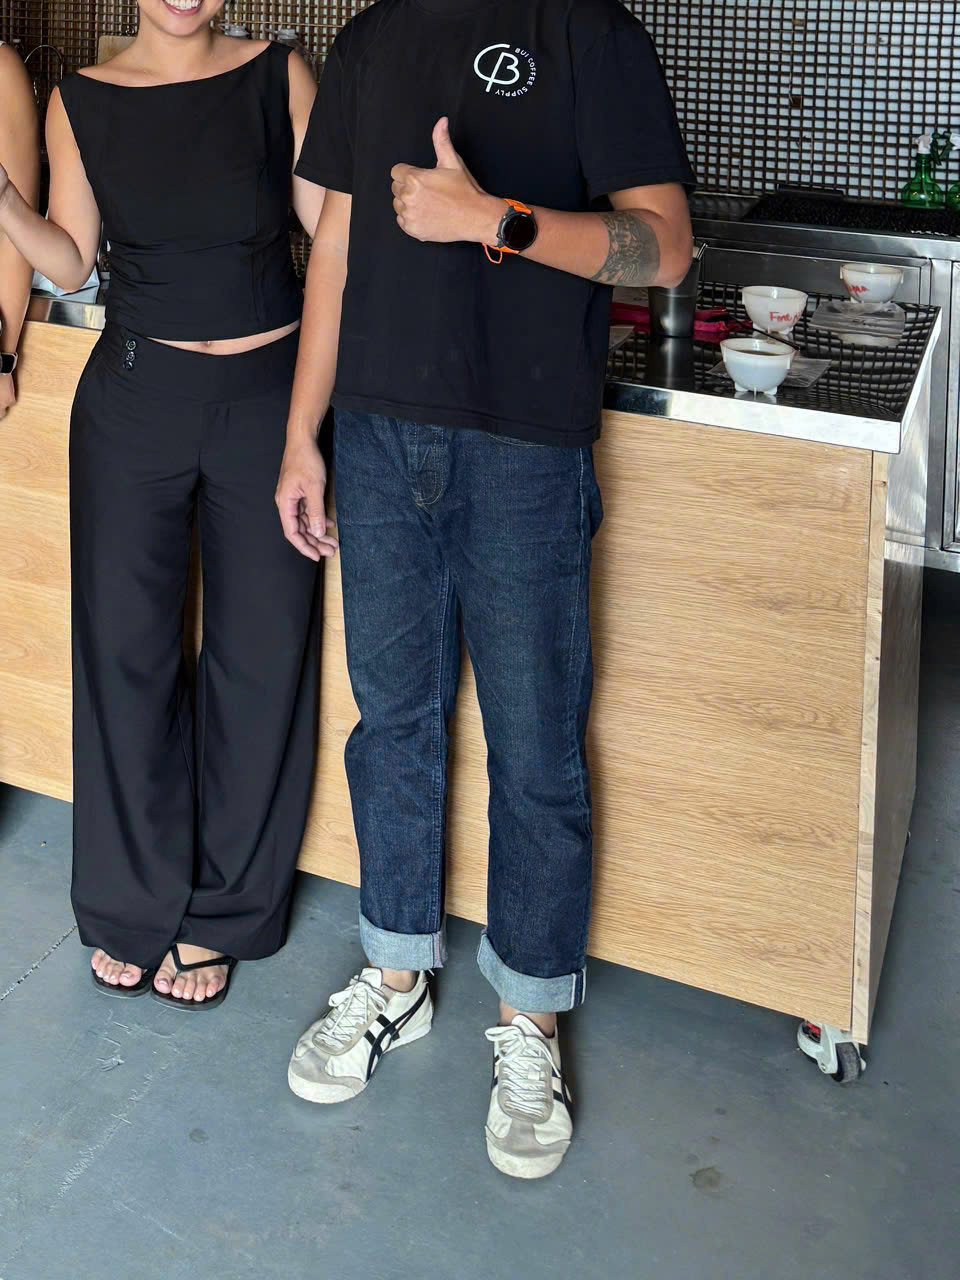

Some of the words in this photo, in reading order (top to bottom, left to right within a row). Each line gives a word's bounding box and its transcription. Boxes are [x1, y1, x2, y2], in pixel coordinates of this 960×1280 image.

[514, 47, 530, 58] BUI
[527, 57, 537, 86] COFFEE
[495, 86, 528, 97] SUPPLY
